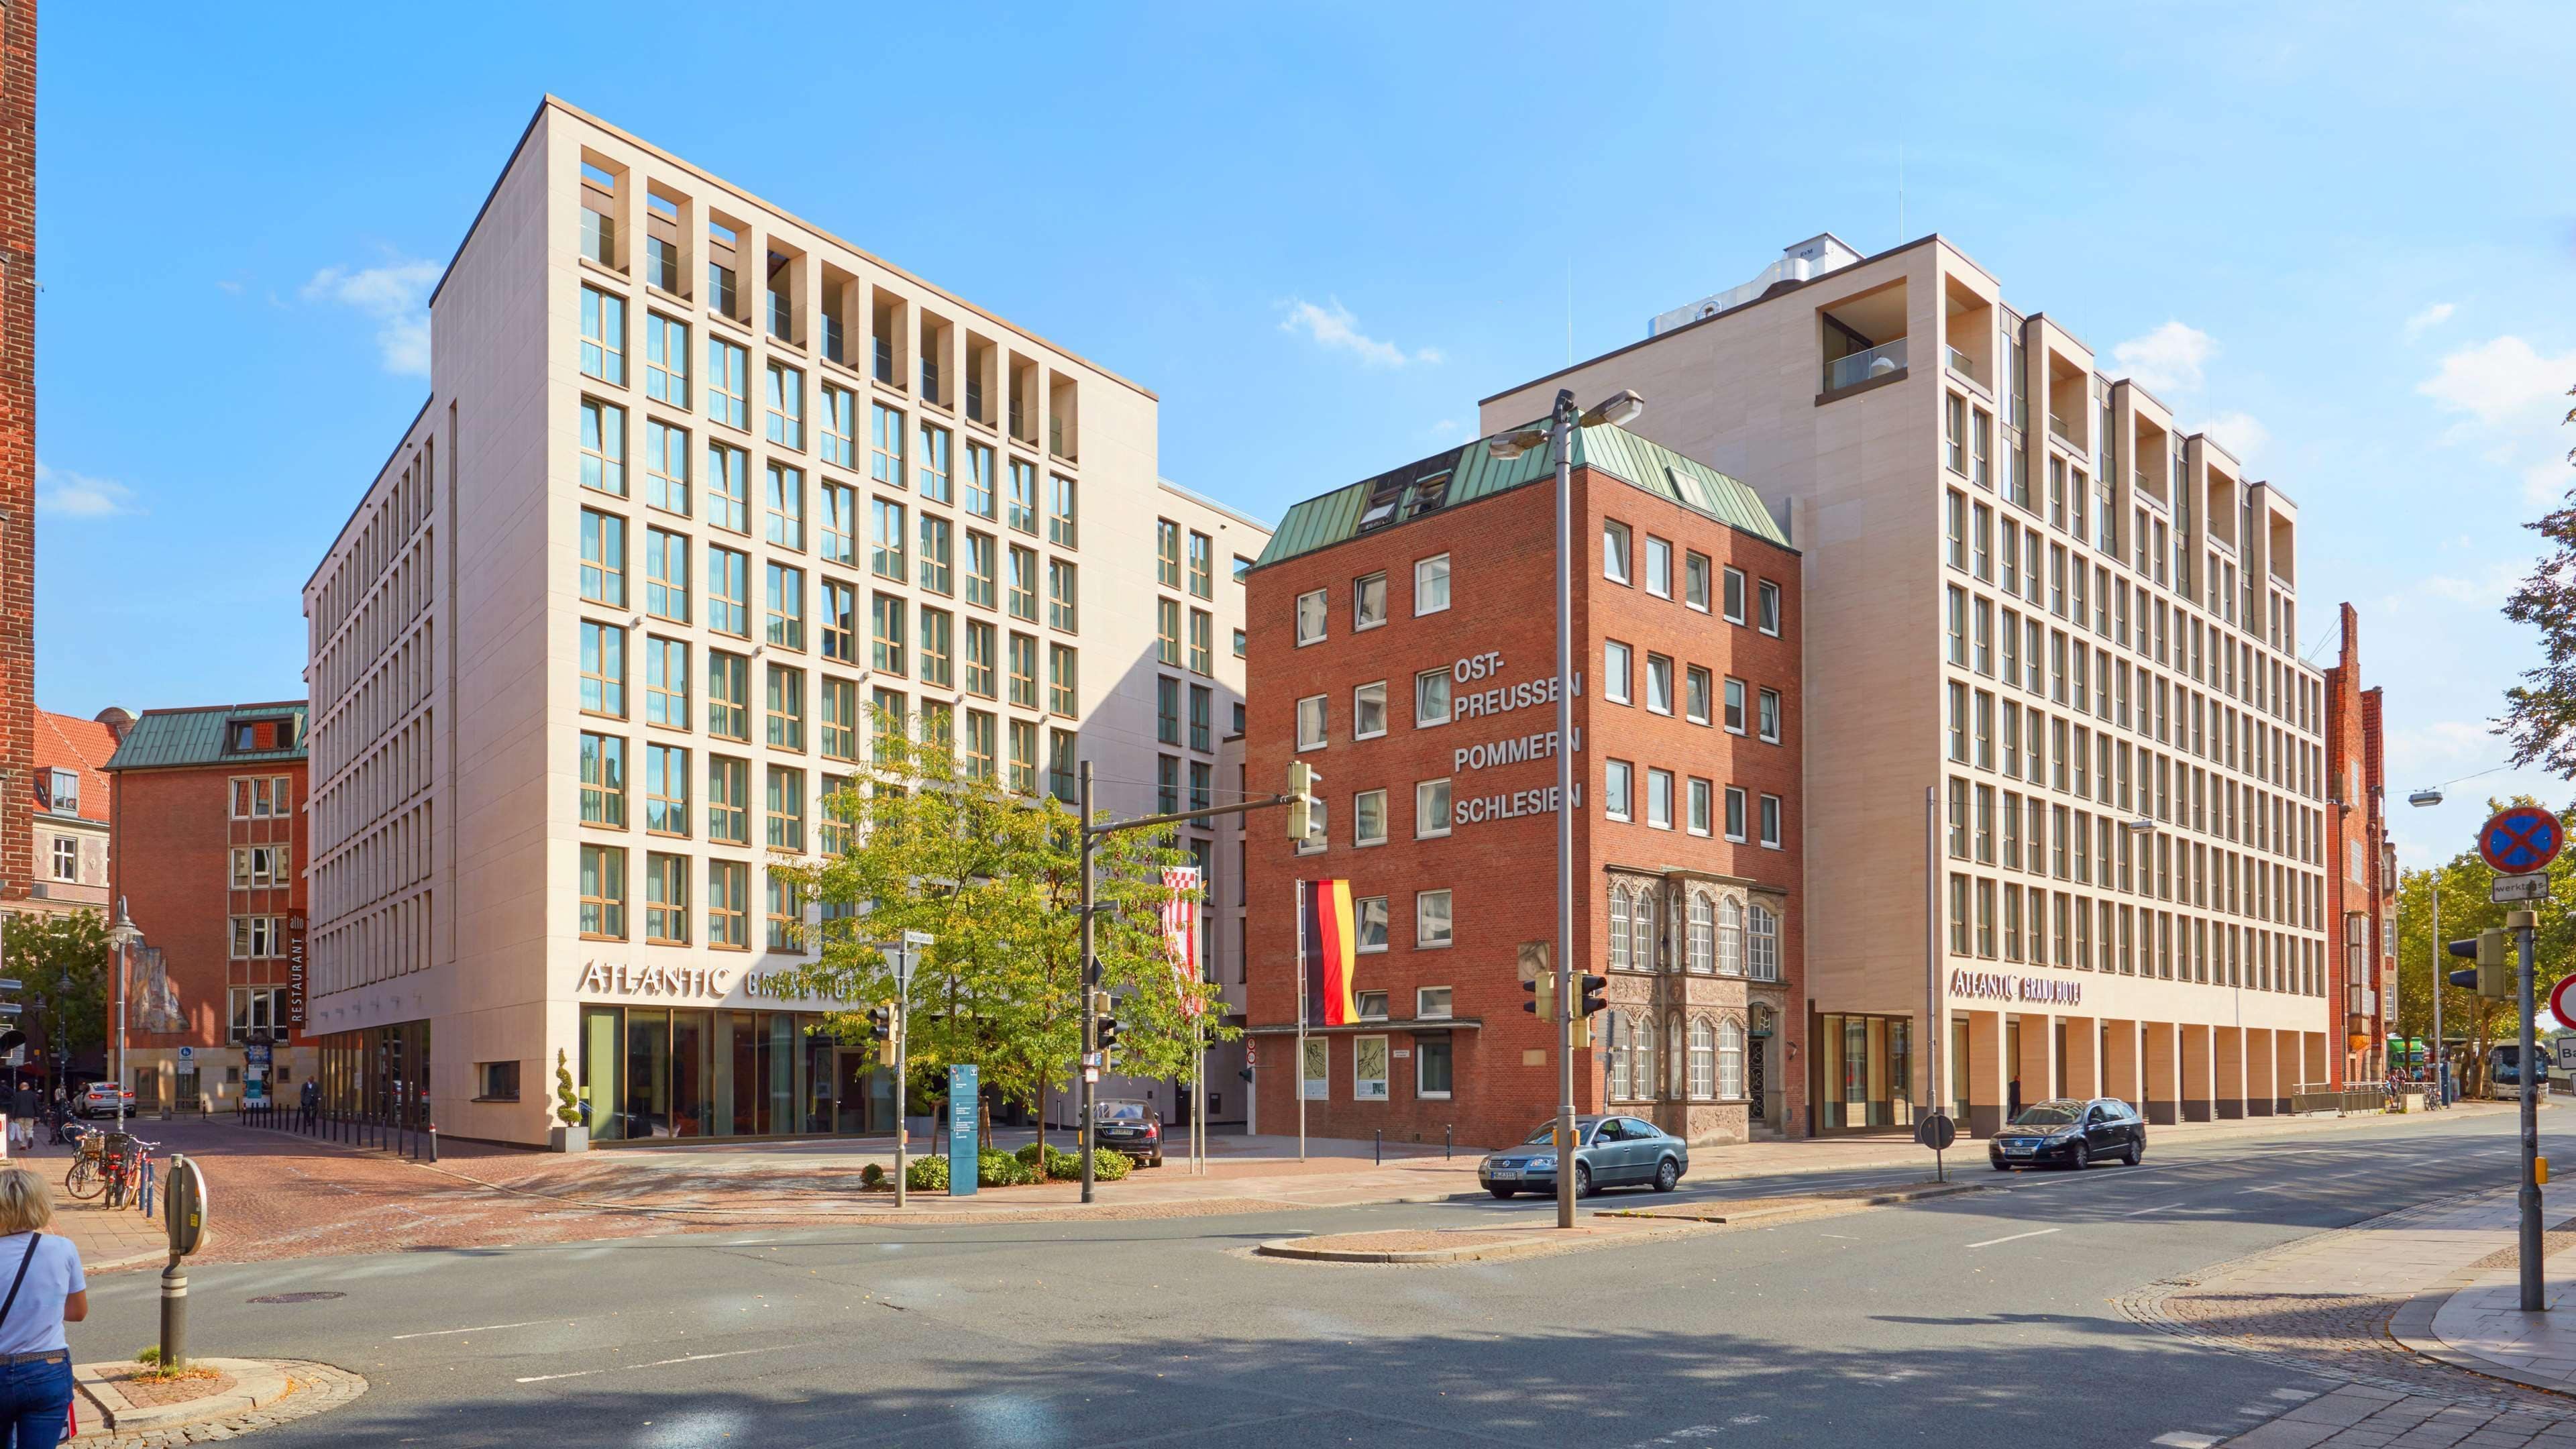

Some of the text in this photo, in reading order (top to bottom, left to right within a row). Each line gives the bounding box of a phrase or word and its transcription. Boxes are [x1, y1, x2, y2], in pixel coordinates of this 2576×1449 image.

[1454, 651, 1503, 682] OST-
[1454, 672, 1581, 720] PREUSSEN
[1454, 727, 1580, 771] POMMERN
[1455, 783, 1581, 824] SCHLESIEN
[290, 915, 304, 929] alto
[292, 938, 302, 1021] RESTAURANT
[581, 959, 731, 996] ATLANTIC
[1953, 967, 2082, 1002] ATLANTIC GRAND HOTEL
